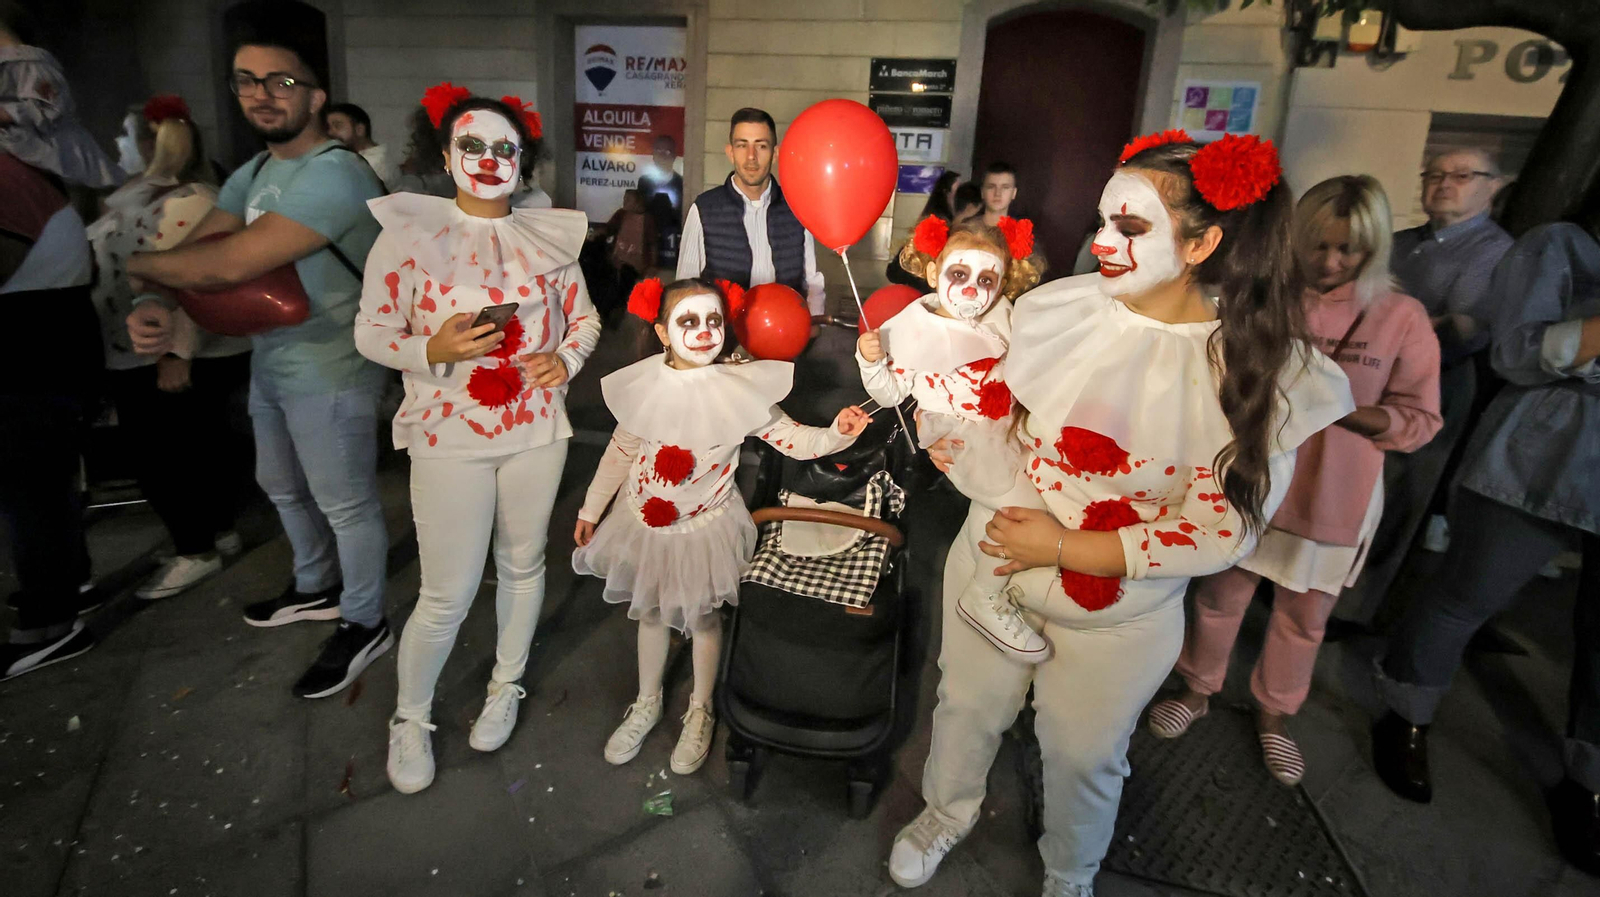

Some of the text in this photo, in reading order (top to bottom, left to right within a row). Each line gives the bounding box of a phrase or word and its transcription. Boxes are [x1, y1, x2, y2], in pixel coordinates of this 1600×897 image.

[1447, 38, 1571, 84] PO
[664, 81, 687, 90] XER
[583, 109, 651, 126] ALQUILA
[583, 133, 636, 150] VENDE
[582, 155, 636, 174] ÁLVARO
[580, 177, 637, 189] PEREZ-LUNA
